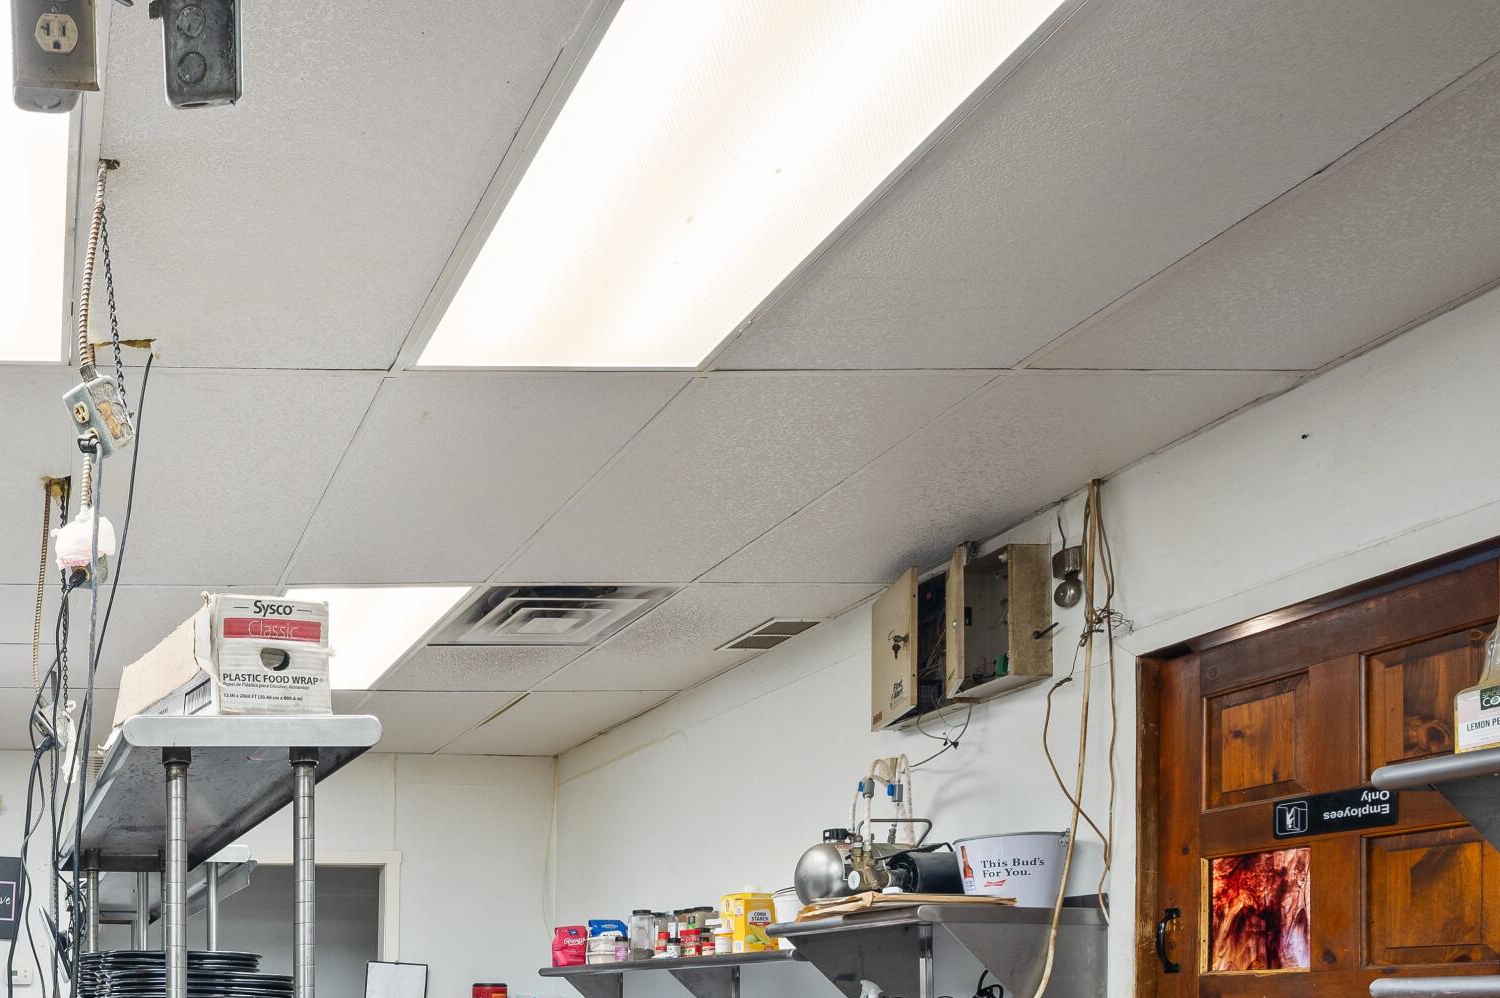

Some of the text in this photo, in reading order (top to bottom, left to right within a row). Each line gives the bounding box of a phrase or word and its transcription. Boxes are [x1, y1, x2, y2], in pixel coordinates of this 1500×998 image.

[253, 600, 293, 617] Sysco
[248, 619, 299, 639] Classic
[222, 672, 261, 682] PLASTIC
[263, 674, 290, 684] FOOD
[1466, 719, 1490, 732] LEMON
[1360, 790, 1390, 802] Only
[1323, 804, 1390, 820] Employees
[981, 857, 1045, 869] This Bud's
[983, 867, 1032, 878] For You.
